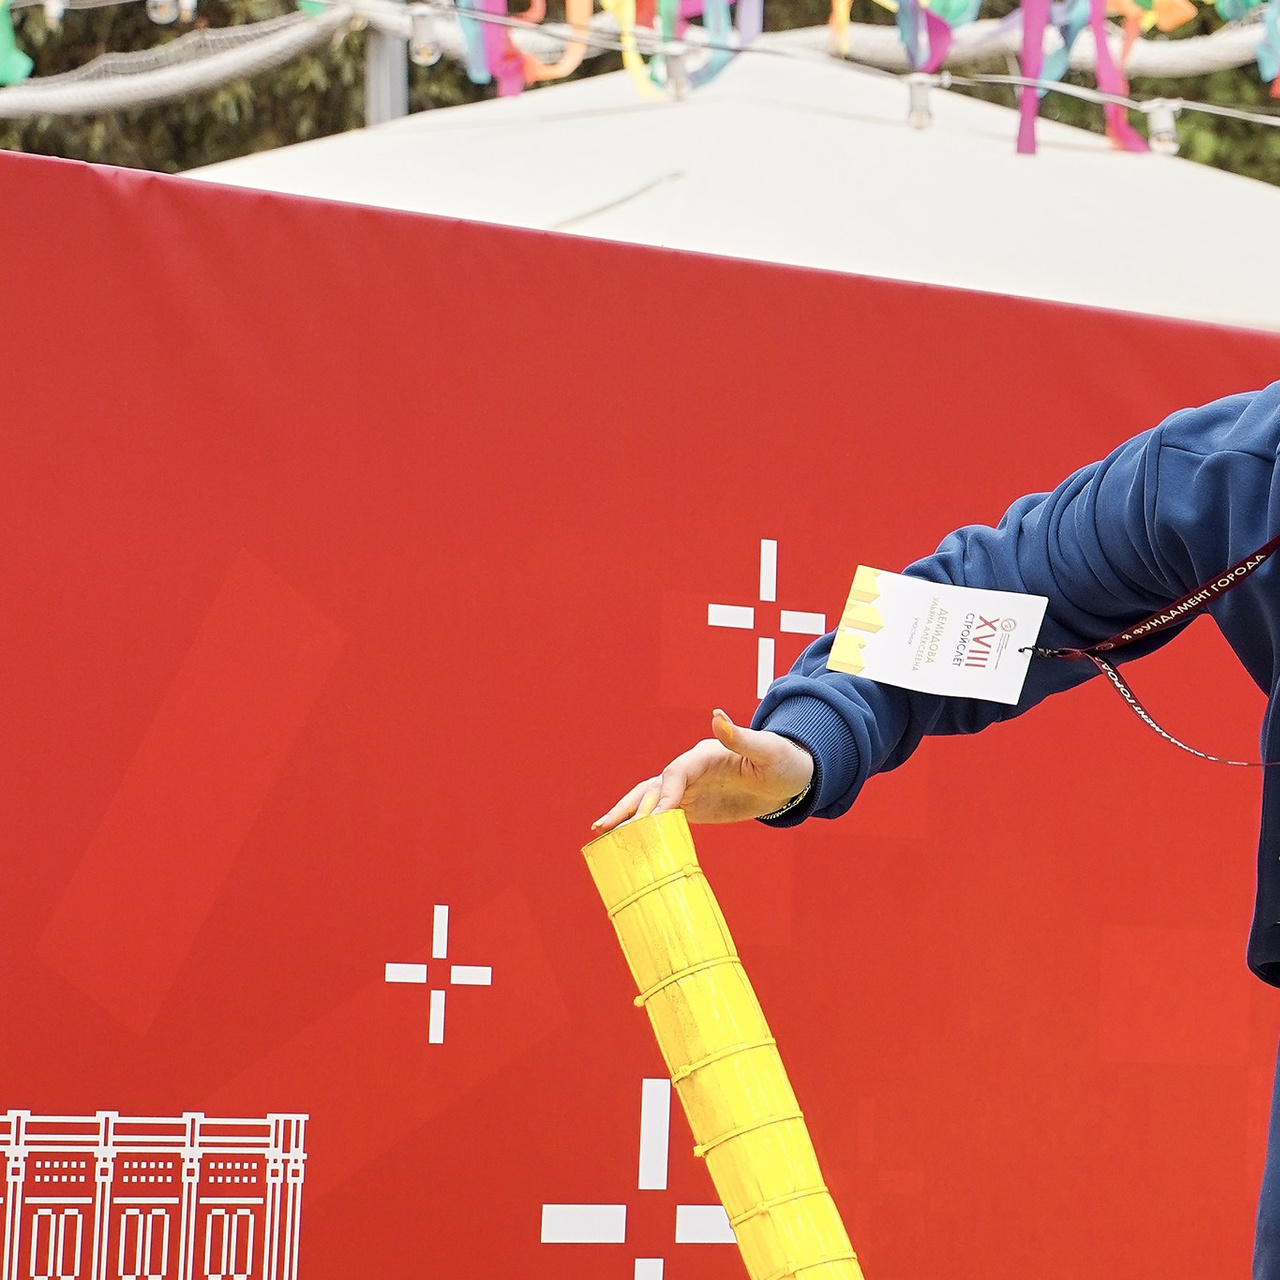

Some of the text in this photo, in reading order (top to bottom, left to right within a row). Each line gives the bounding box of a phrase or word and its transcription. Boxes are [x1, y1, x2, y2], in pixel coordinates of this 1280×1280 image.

[1133, 589, 1212, 636] ФУНДАМЕНТ
[1210, 553, 1266, 593] ГОРОДА
[952, 612, 976, 667] СТРОЙСЛЁТ
[964, 615, 1000, 669] XVIII
